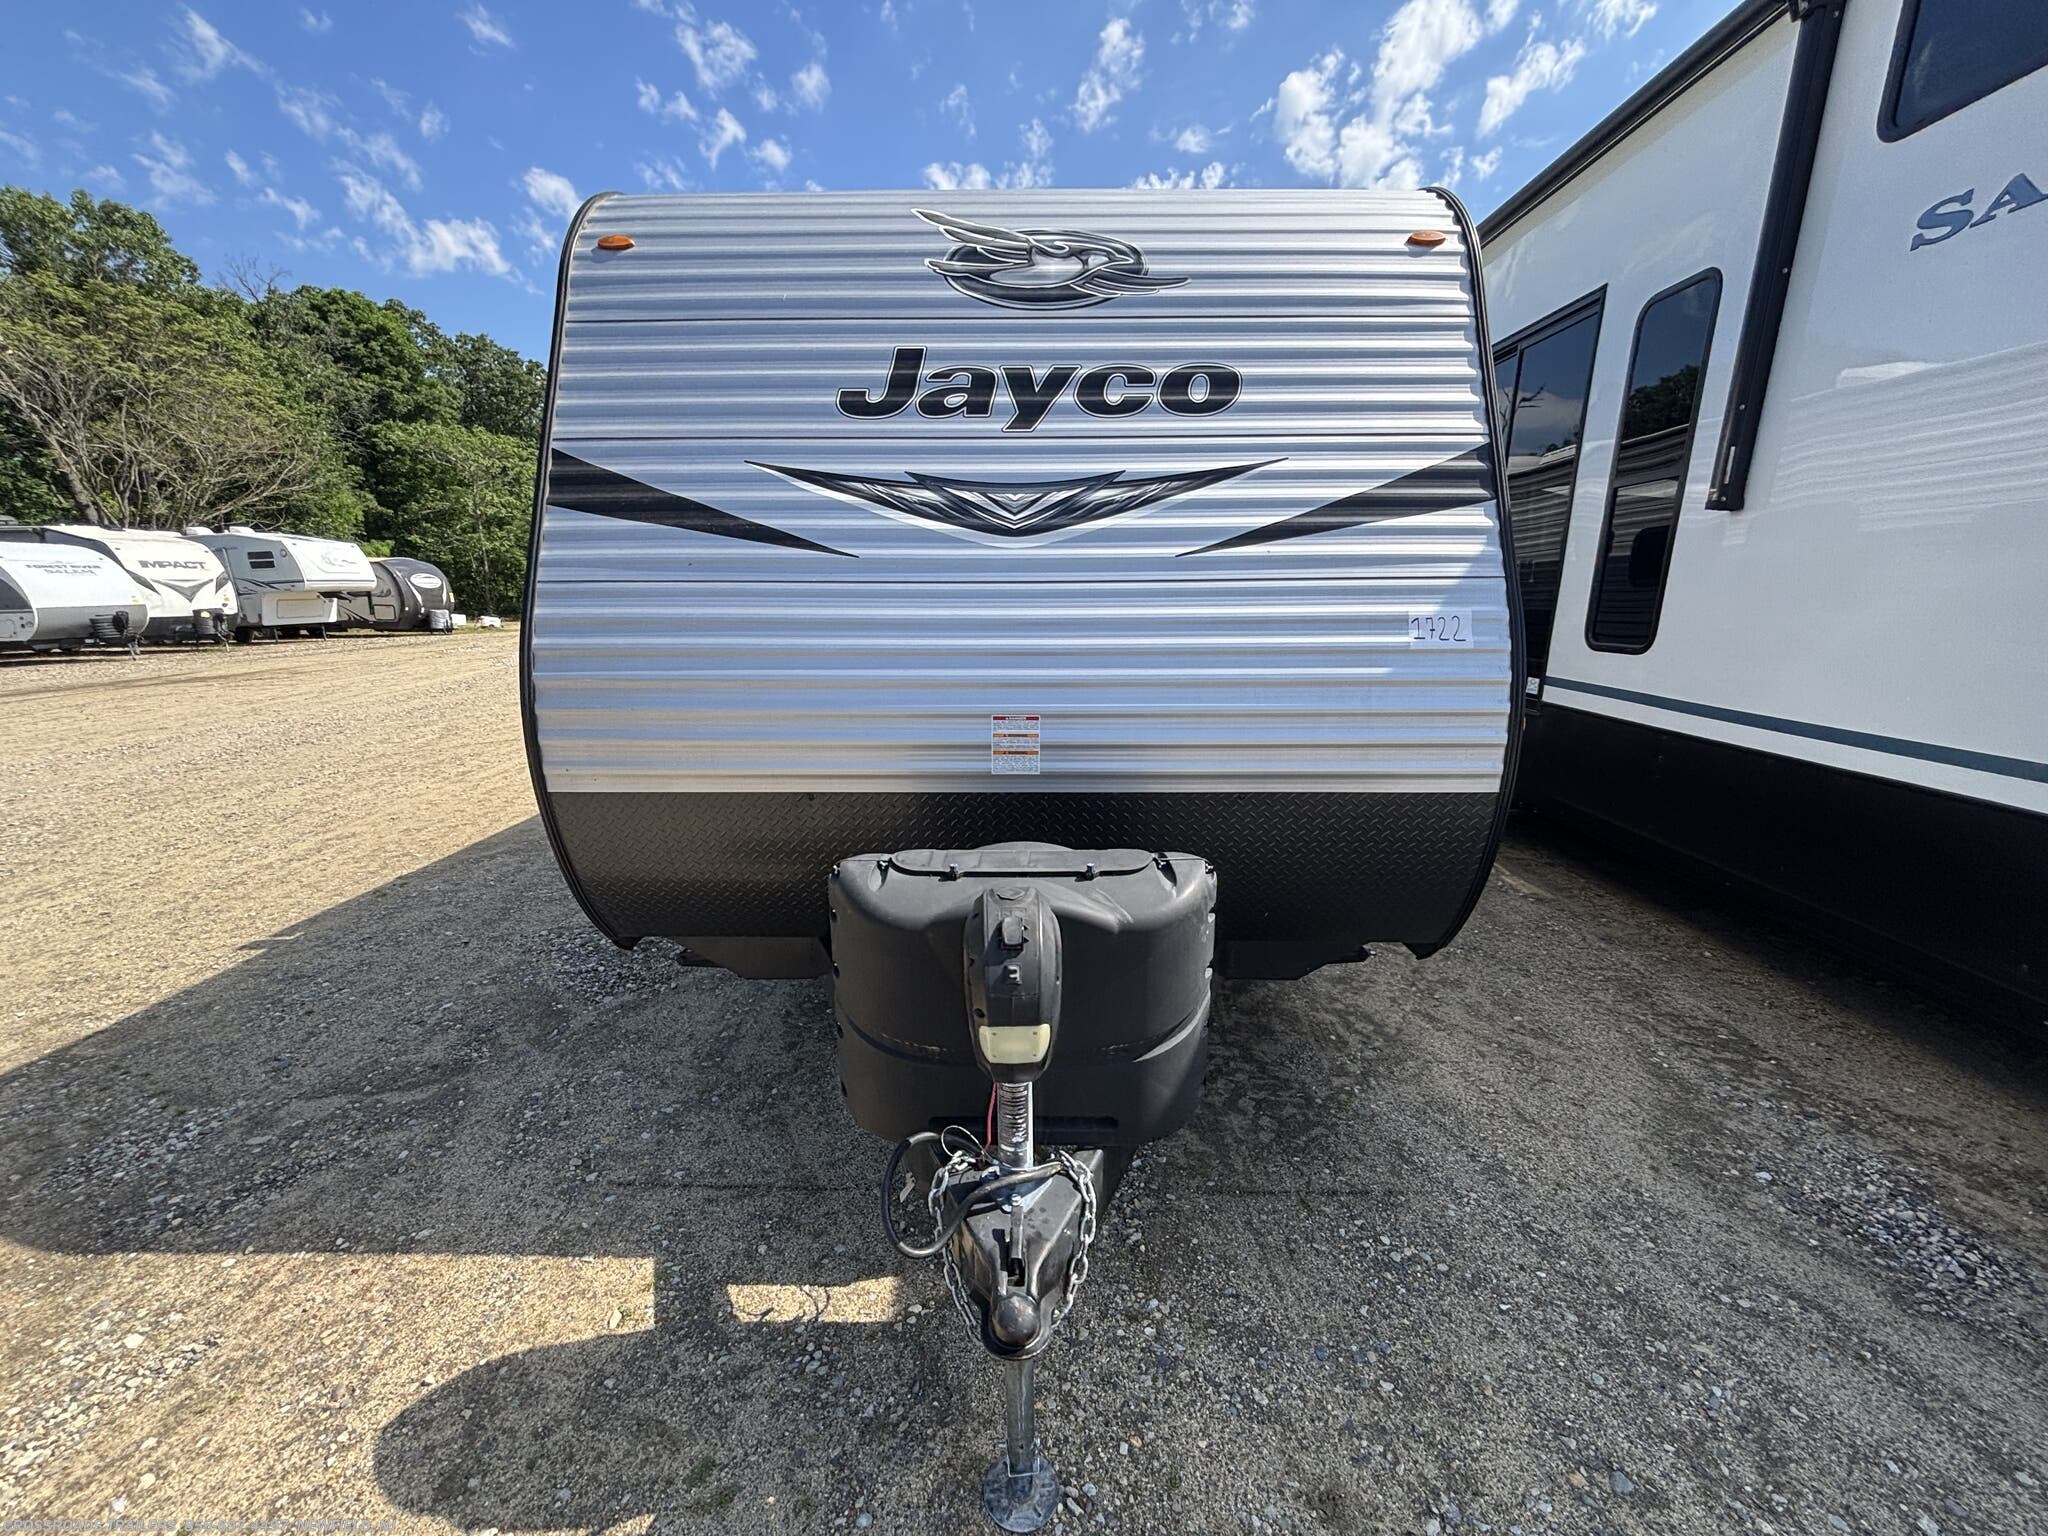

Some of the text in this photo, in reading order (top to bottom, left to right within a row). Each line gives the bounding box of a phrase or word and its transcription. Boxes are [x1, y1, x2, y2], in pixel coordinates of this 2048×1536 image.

[836, 345, 1243, 433] Jayco
[138, 560, 207, 570] IMPACT
[1410, 615, 1467, 642] 1722
